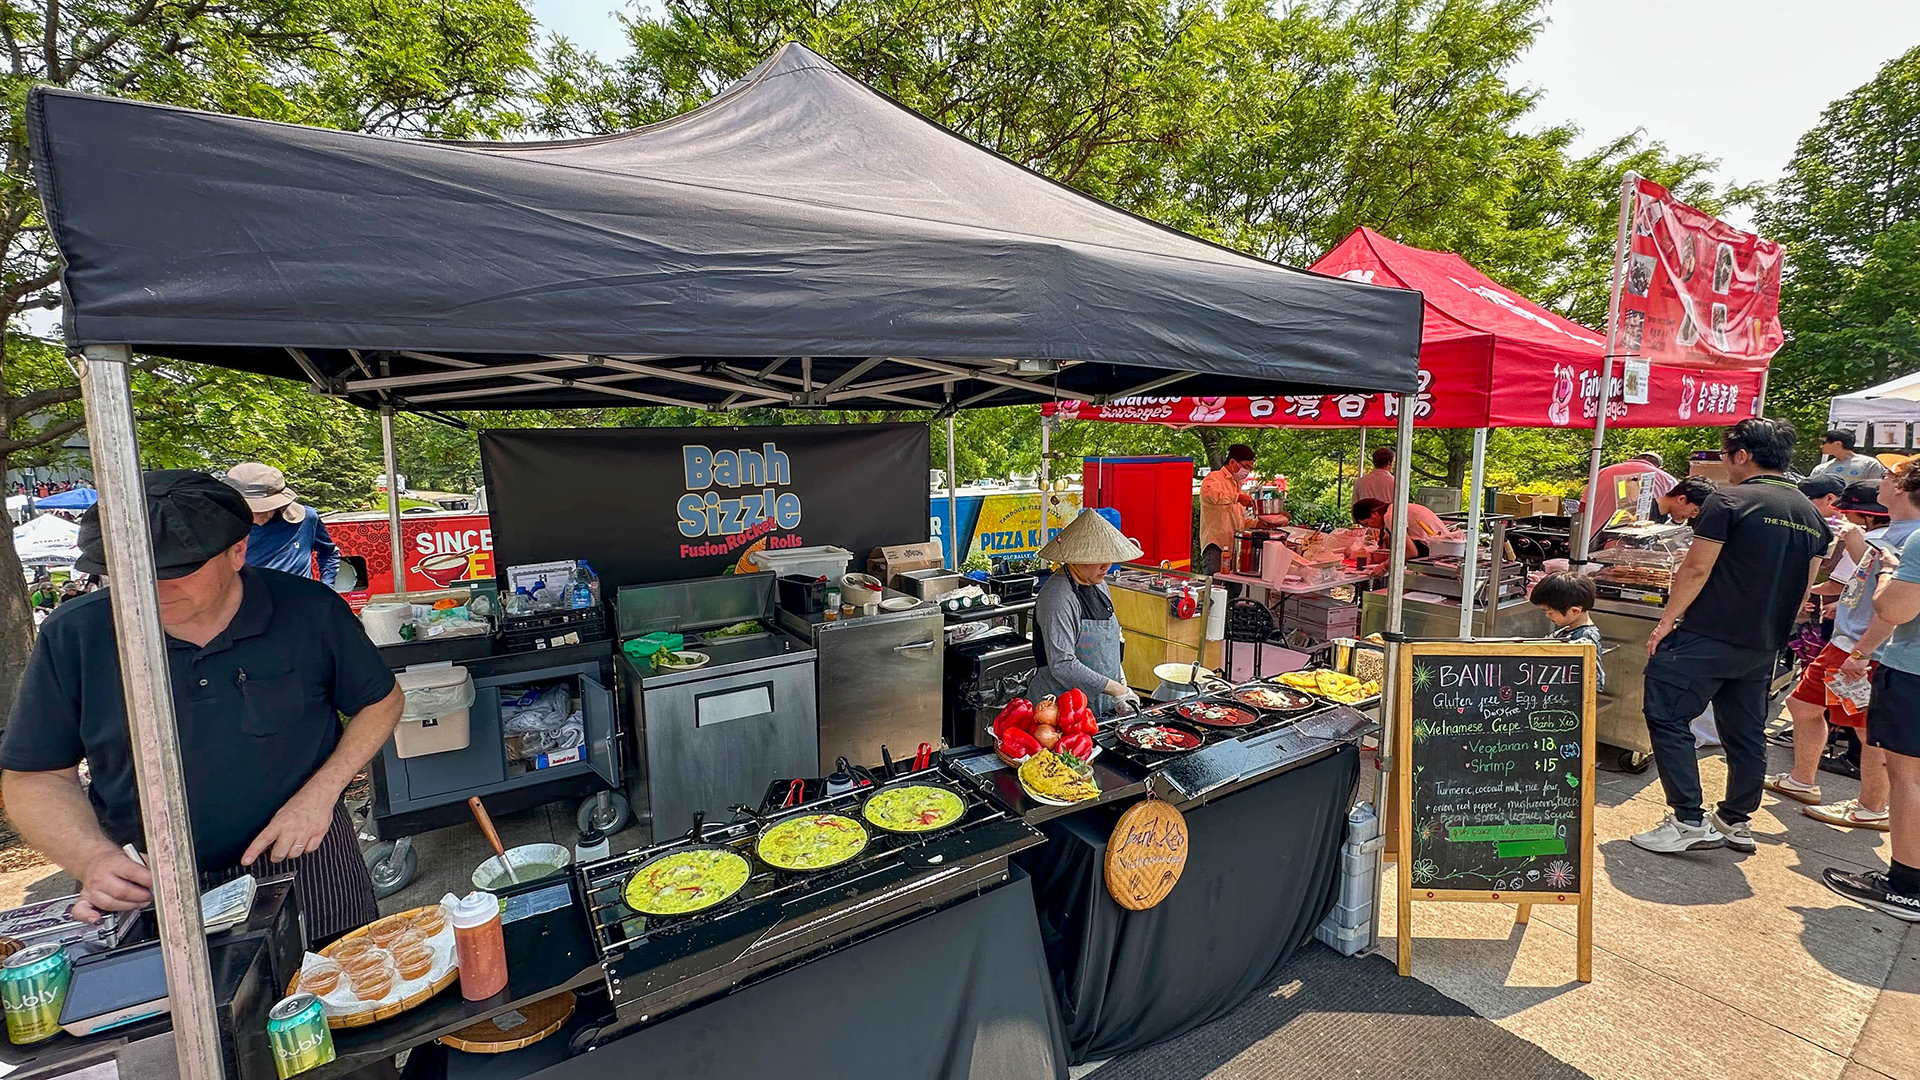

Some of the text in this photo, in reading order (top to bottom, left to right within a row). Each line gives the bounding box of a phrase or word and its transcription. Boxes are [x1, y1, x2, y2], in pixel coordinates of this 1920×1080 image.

[682, 442, 791, 490] Banh
[677, 488, 801, 538] Sizzle
[1763, 517, 1778, 525] THE
[416, 528, 494, 554] SINCE
[680, 515, 803, 558] Fusion Rocket Rolls
[981, 530, 1023, 551] PIZZA
[1440, 663, 1501, 687] BANH
[1433, 691, 1473, 708] Gluten
[1516, 691, 1537, 710] Egg
[1423, 719, 1484, 736] Vietnamese
[1469, 739, 1529, 760] Vegetarian
[1471, 759, 1515, 777] Shrimp
[1885, 892, 1920, 907] HOKA
